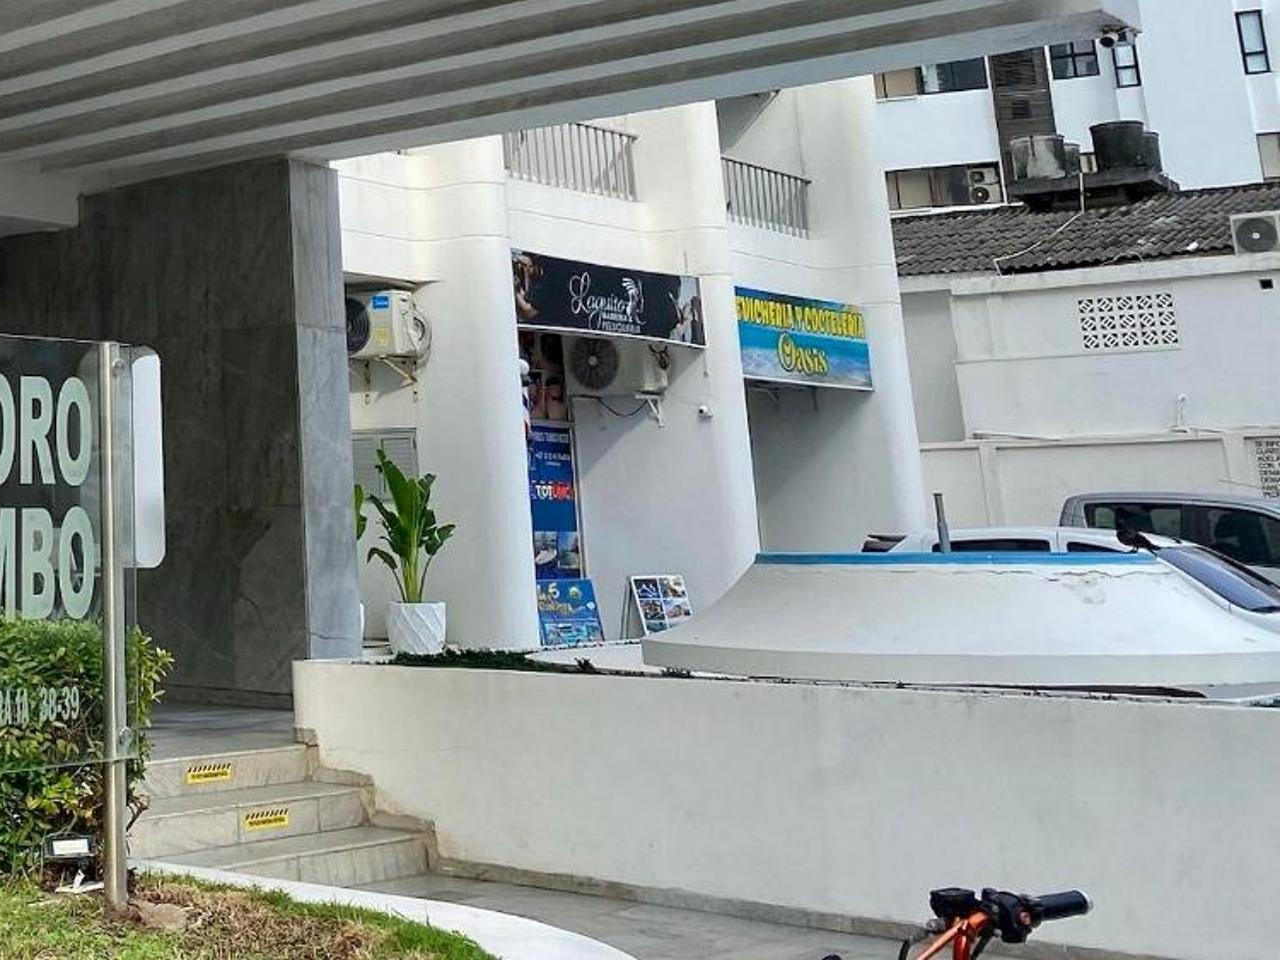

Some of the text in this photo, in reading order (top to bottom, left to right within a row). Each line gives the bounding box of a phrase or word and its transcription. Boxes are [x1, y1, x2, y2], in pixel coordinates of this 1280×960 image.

[734, 296, 793, 328] EVICHERIA
[794, 305, 804, 330] Y
[779, 333, 828, 375] Oasis
